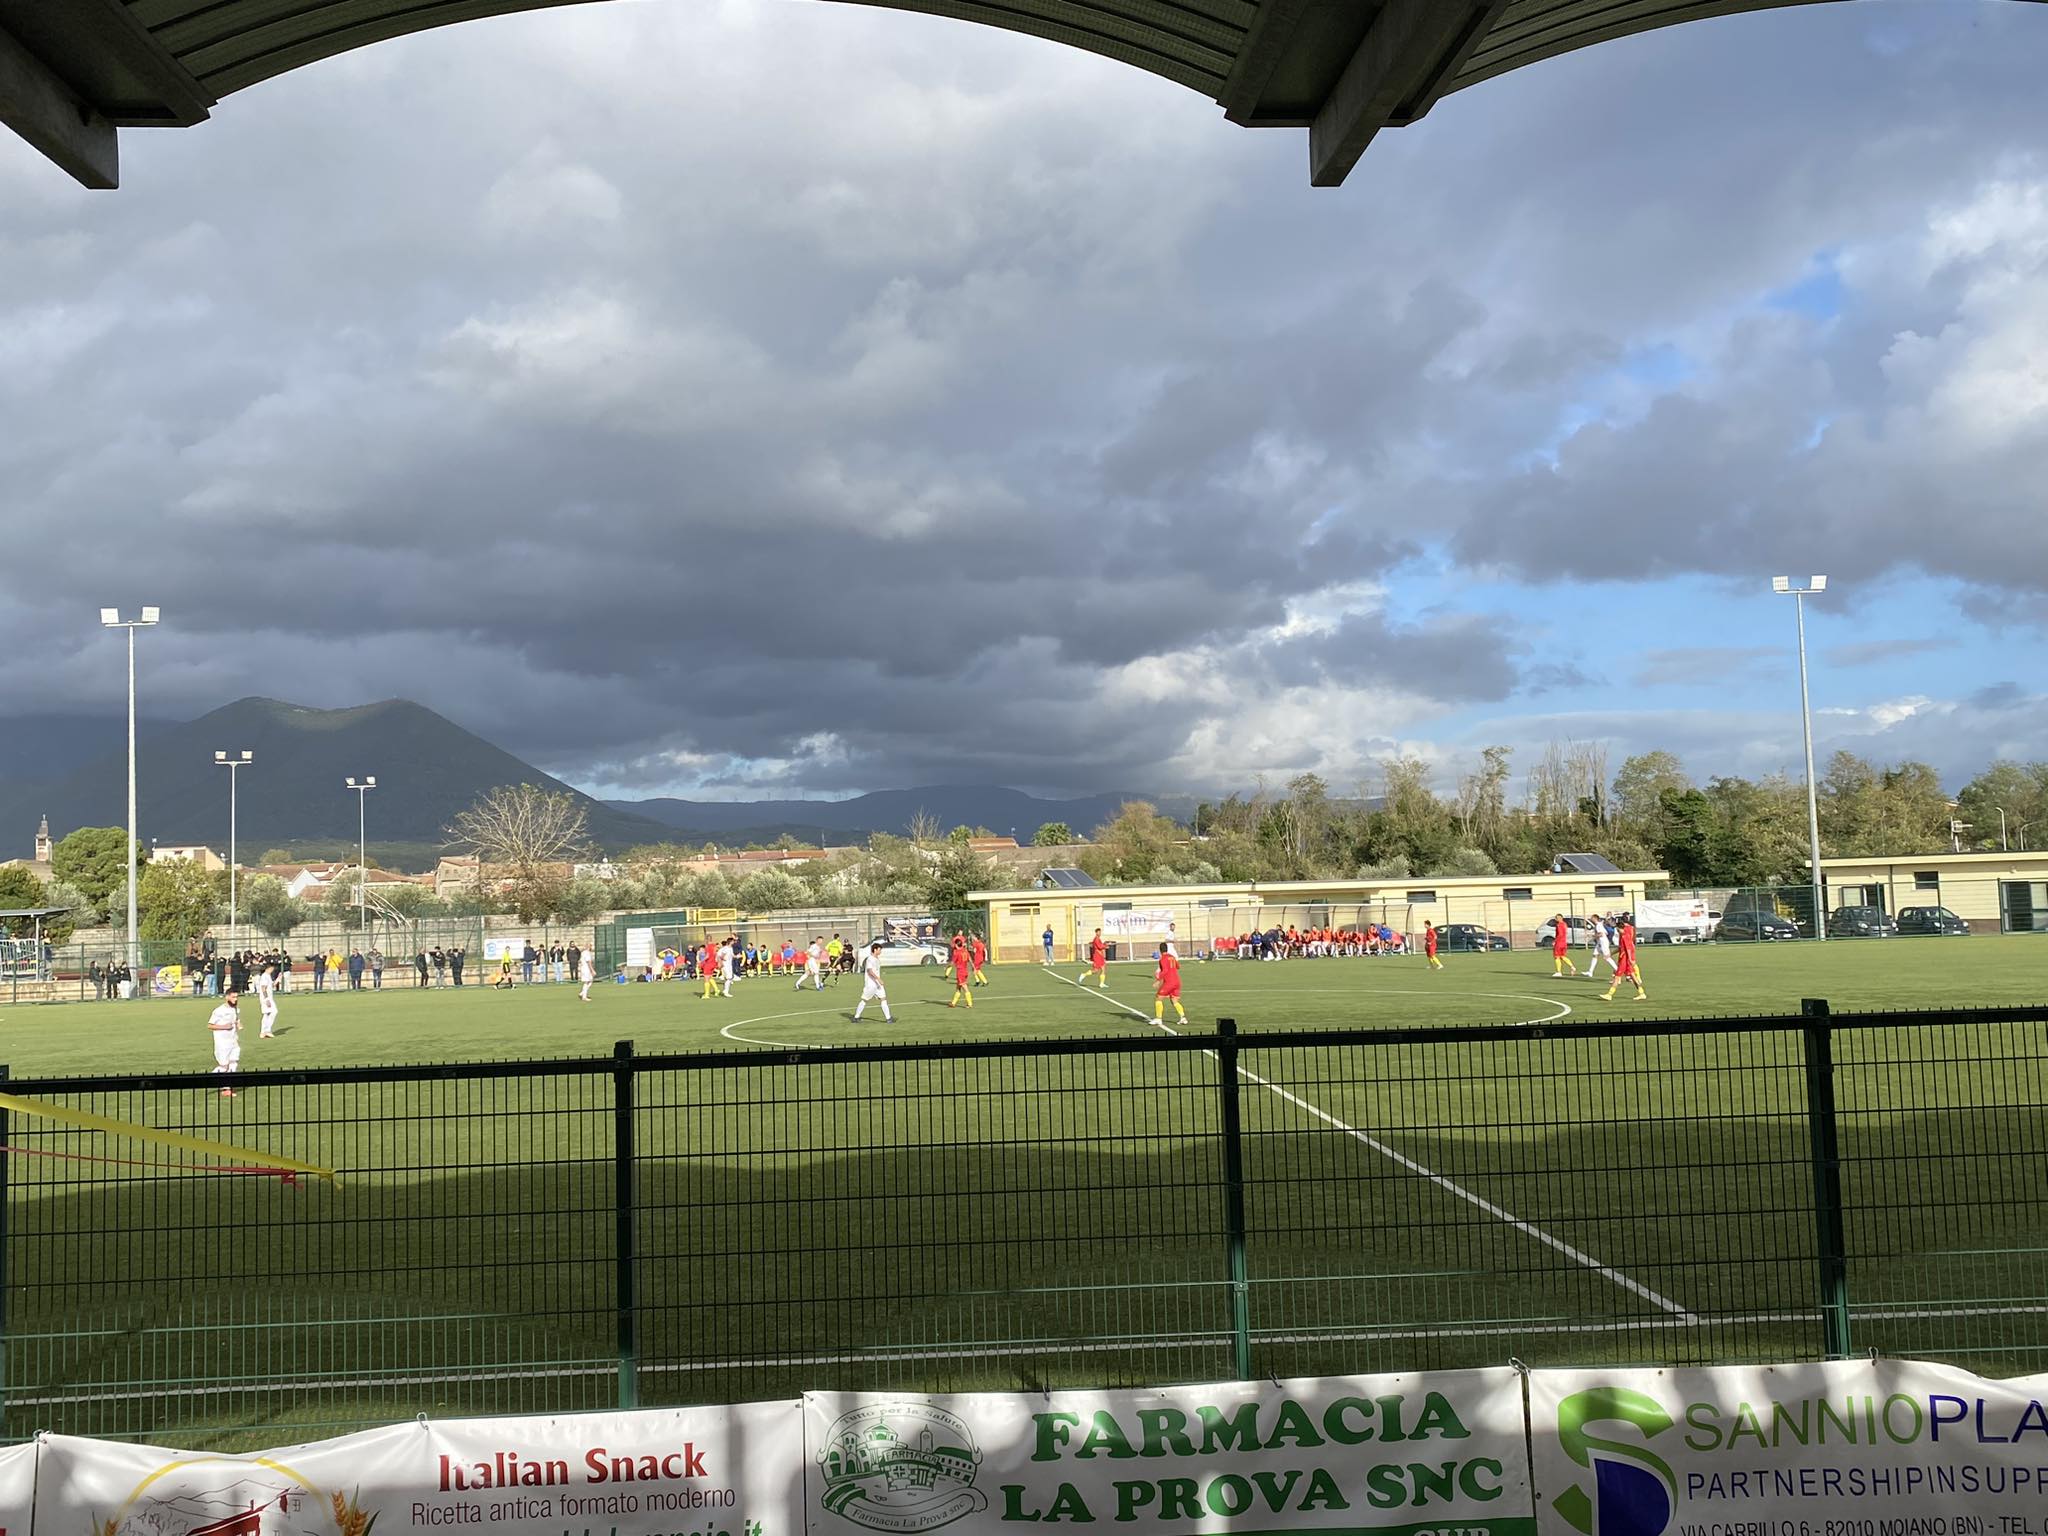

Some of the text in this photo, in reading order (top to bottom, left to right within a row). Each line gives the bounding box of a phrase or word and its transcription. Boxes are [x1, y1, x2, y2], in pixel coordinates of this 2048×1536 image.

[840, 1406, 964, 1430] Tutto per la Salute
[1031, 1392, 1471, 1462] FARMACIA
[1684, 1393, 2048, 1451] SANNIOPLA
[438, 1442, 709, 1492] Italian Snack
[411, 1487, 736, 1526] Ricetta antica formato moderno
[1000, 1457, 1503, 1522] LA PROVA SNC
[851, 1501, 966, 1528] Farmacia La Prova snc
[1826, 1519, 1875, 1536] 82010
[1880, 1517, 1947, 1536] MOIANO
[1952, 1515, 1984, 1536] (BN)
[1999, 1516, 2038, 1535] TEL.
